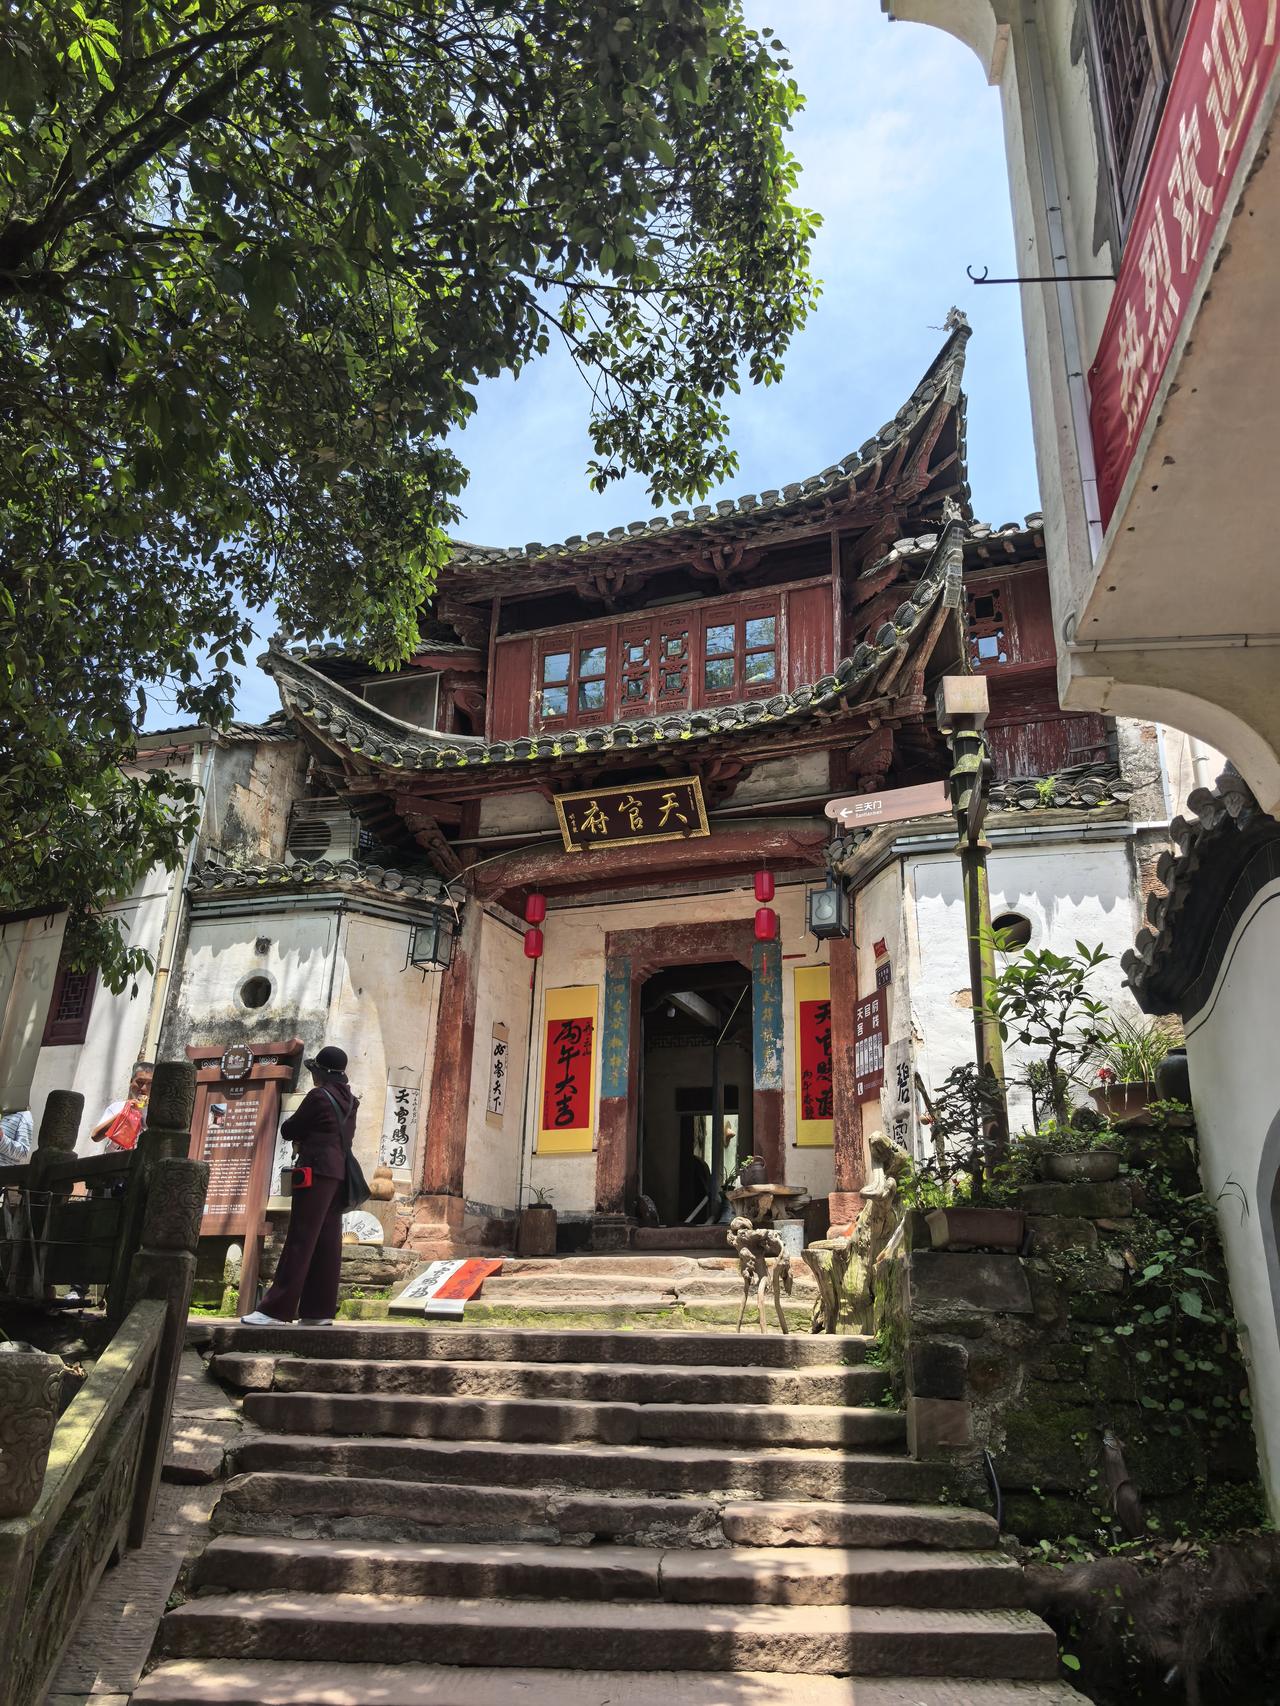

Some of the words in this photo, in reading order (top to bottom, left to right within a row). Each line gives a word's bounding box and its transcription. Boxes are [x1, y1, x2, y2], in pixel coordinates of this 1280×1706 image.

[1118, 0, 1277, 447] 热烈欢迎
[580, 791, 689, 836] 天官府
[855, 800, 882, 812] 三天门
[856, 1000, 879, 1021] 天官府
